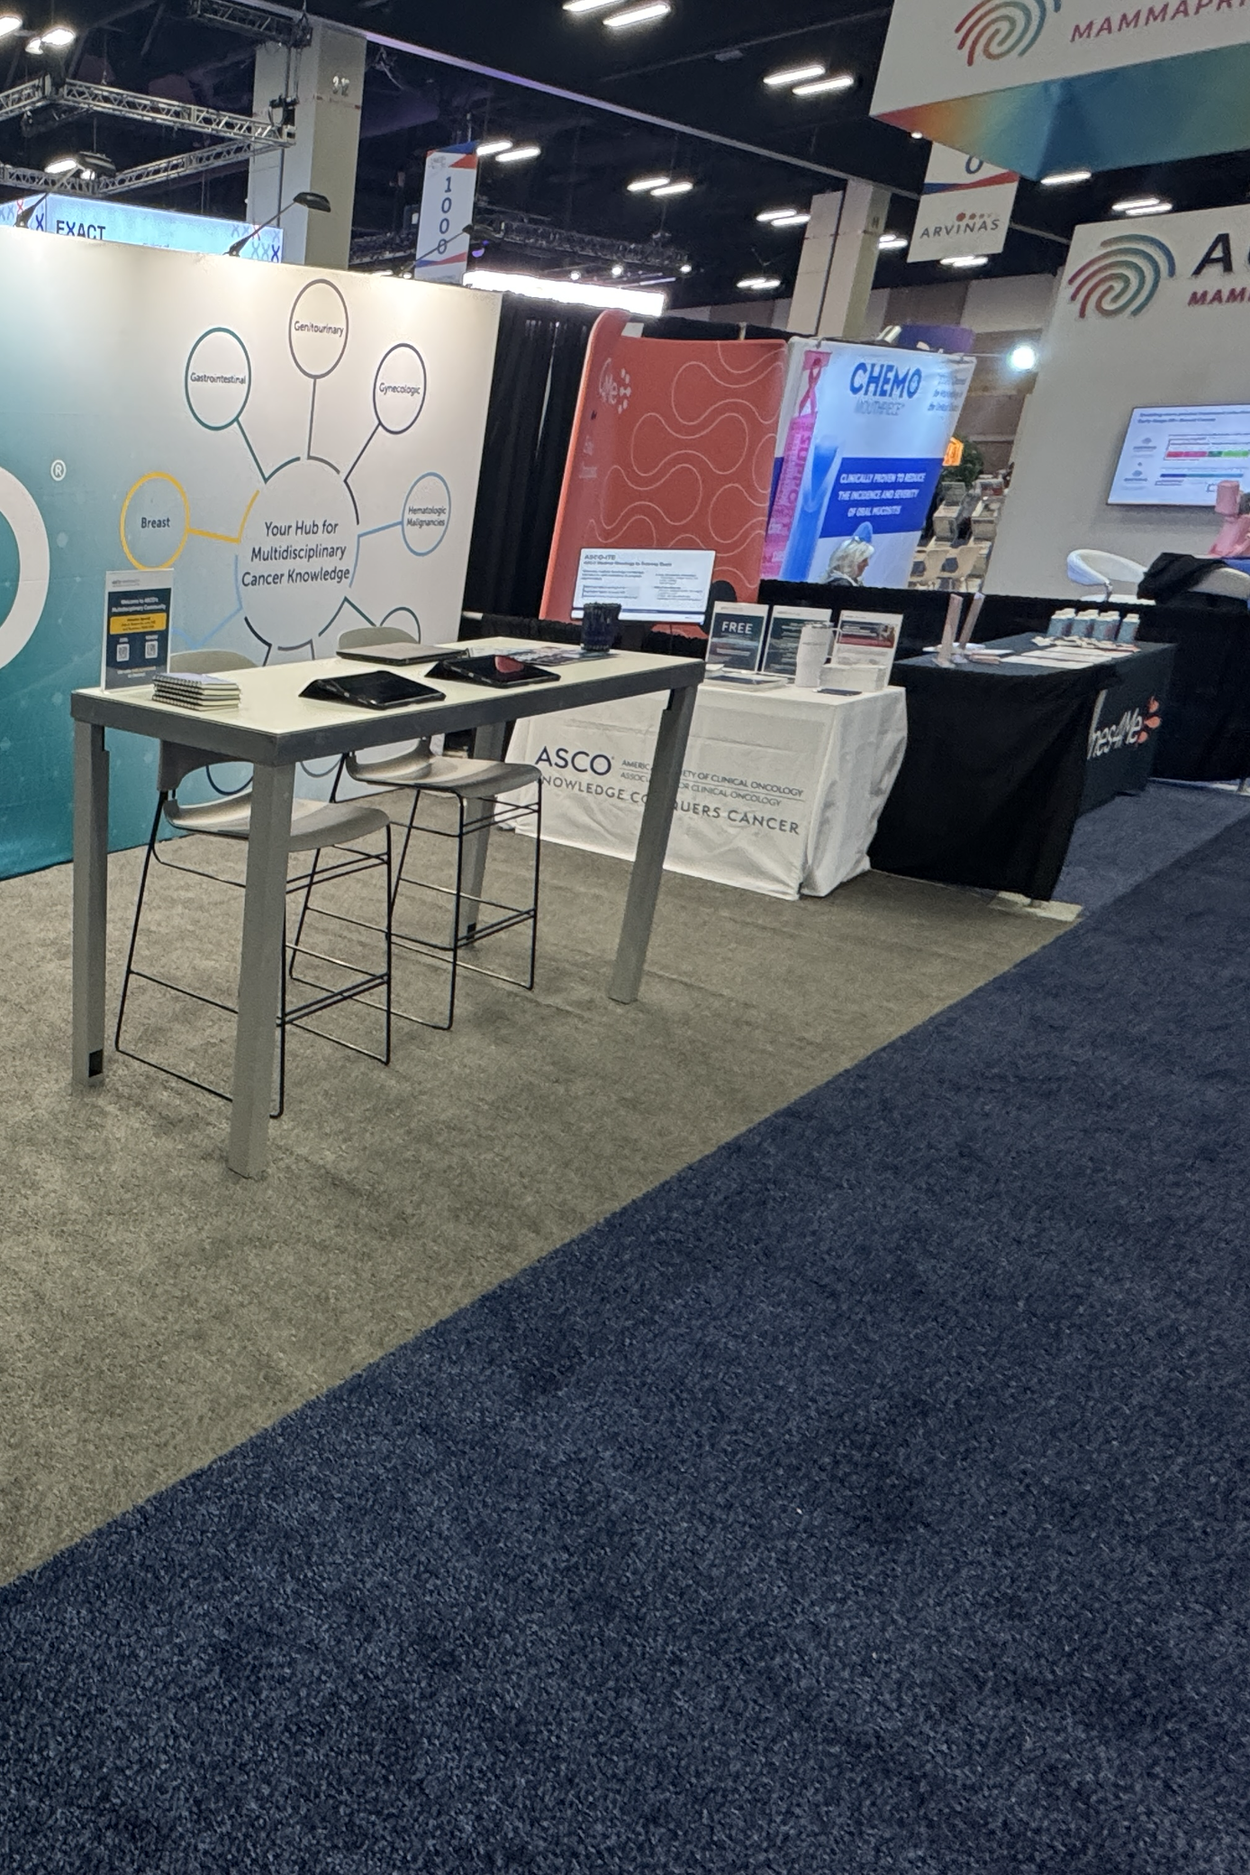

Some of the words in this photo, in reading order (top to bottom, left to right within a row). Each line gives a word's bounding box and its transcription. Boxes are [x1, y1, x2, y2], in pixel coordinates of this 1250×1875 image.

[920, 219, 1000, 239] ARVINAS
[1191, 233, 1250, 276] A
[1187, 287, 1250, 306] MAM
[294, 321, 344, 337] Genitourinary
[190, 372, 247, 385] Gastrointestinal
[850, 362, 922, 399] CHEMO
[378, 382, 421, 396] Gynecologic
[408, 506, 447, 517] Hematologic
[140, 516, 171, 529] Breast
[264, 521, 291, 537] Your
[295, 520, 318, 535] Hub
[321, 519, 339, 534] for
[406, 518, 445, 529] Malignancies
[251, 544, 347, 562] Multidisciplinary
[242, 571, 285, 587] Cancer
[287, 568, 350, 584] Knowledge
[721, 620, 753, 634] FREE
[535, 746, 612, 776] ASCO
[622, 759, 650, 770] AMERIC
[697, 771, 710, 781] OF
[711, 774, 748, 787] CLINICAL
[750, 781, 804, 797] ONCOLOGY
[691, 784, 728, 797] CLINICAL
[730, 791, 782, 806] ONCOLOGY
[542, 776, 625, 800] NOWLEDGE
[727, 810, 800, 835] CANCER
